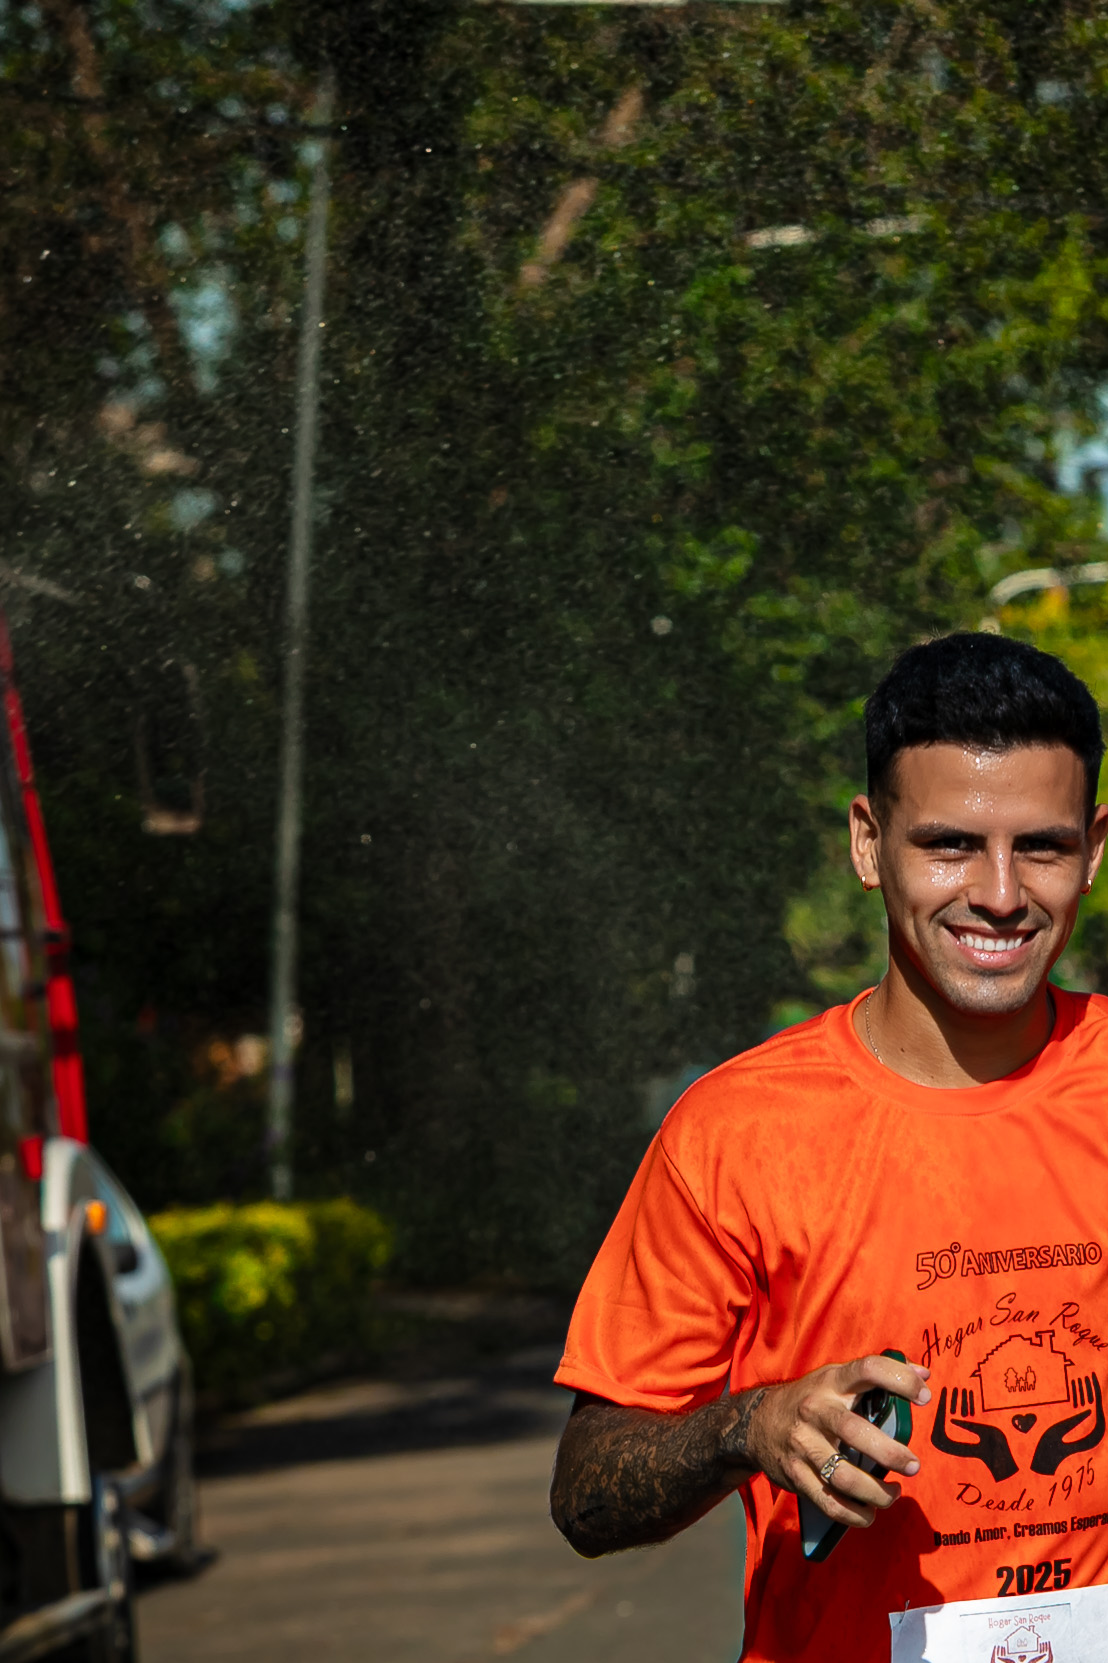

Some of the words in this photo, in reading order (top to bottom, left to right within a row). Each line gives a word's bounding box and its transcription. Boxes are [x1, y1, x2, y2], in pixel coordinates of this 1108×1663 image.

[961, 1242, 1102, 1277] ANIVERSARIO
[920, 1316, 984, 1368] Hogar
[990, 1292, 1040, 1326] San
[955, 1482, 1035, 1511] Desde
[1048, 1457, 1096, 1506] 1975
[934, 1530, 971, 1546] Dando
[1014, 1519, 1067, 1538] Creamos
[996, 1558, 1072, 1597] 2025
[988, 1617, 1012, 1629] Hogar
[1013, 1615, 1027, 1626] San
[1028, 1613, 1051, 1624] Roque
